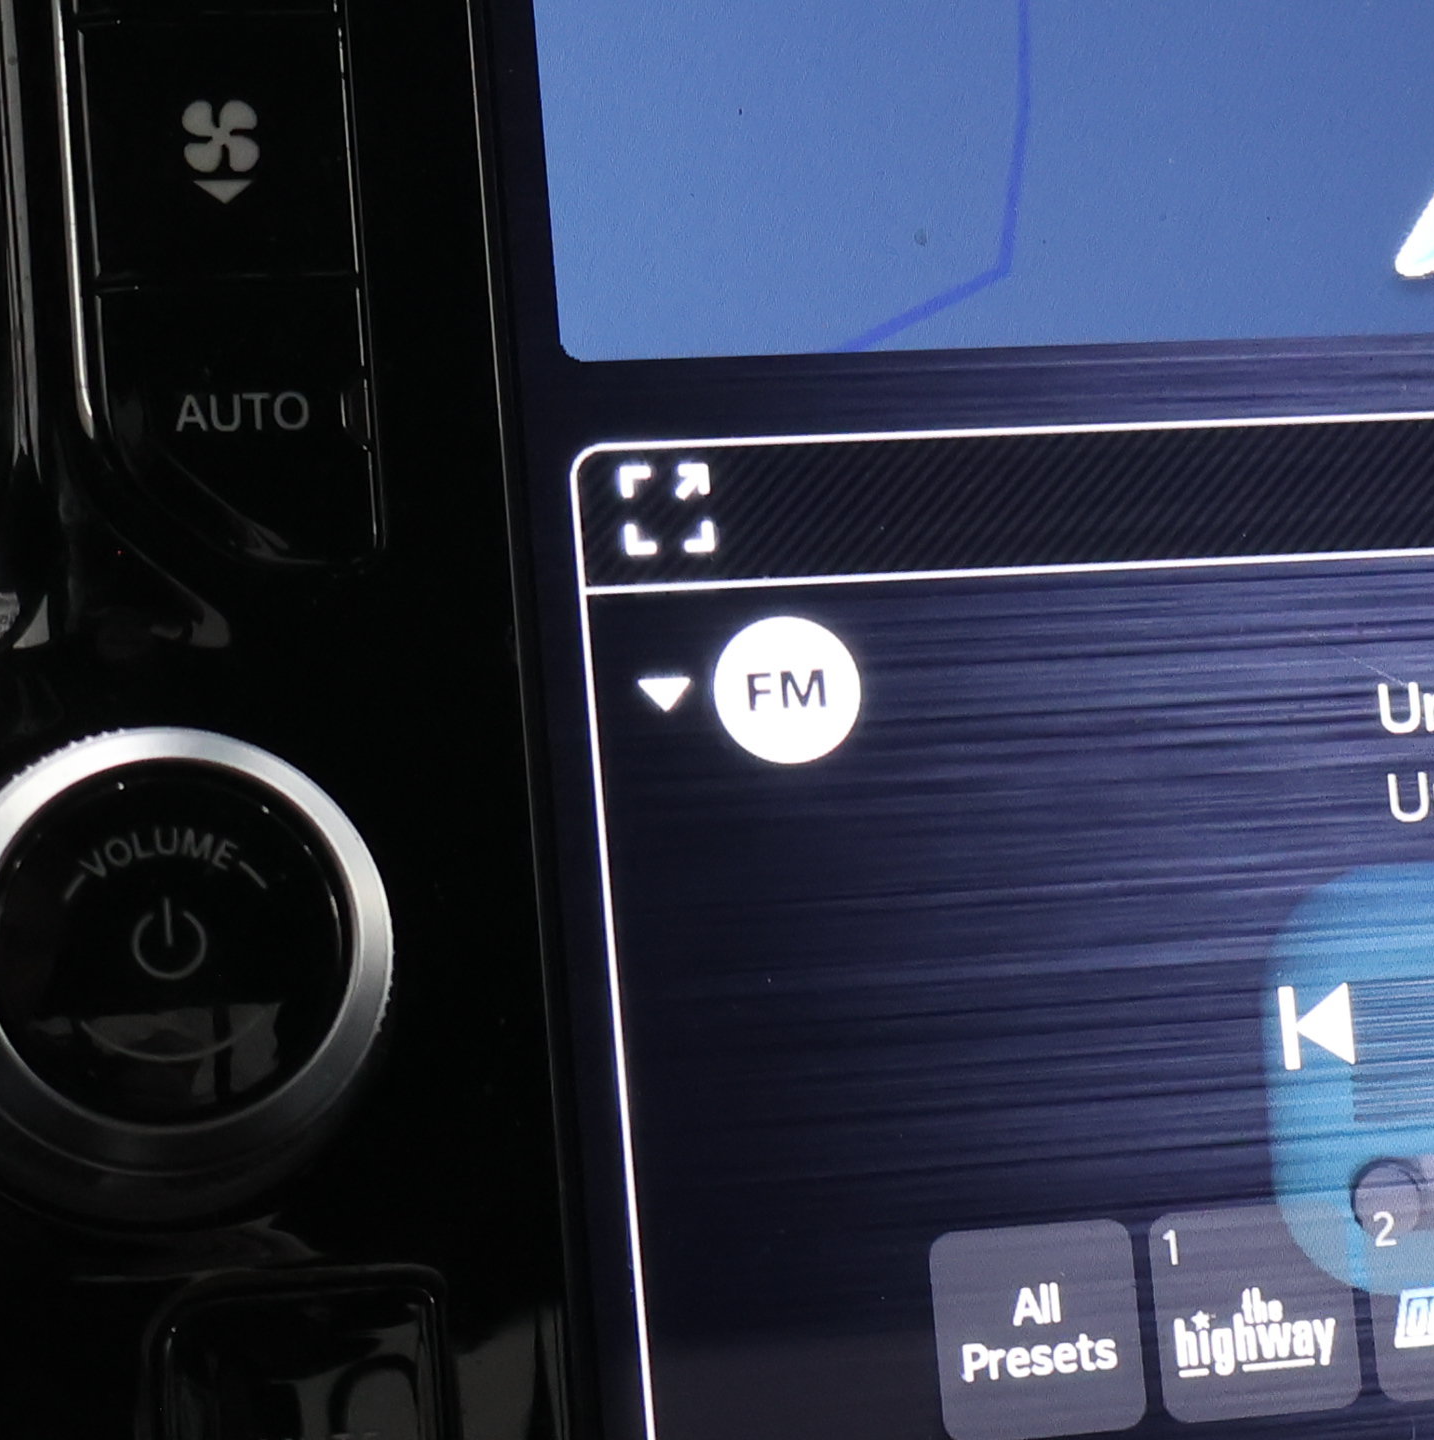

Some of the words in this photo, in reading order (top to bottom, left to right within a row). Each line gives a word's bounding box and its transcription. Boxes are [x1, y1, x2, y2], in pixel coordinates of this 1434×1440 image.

[177, 392, 308, 431] AUTO
[747, 668, 827, 712] FM
[78, 825, 239, 877] VOLUME
[1162, 1228, 1179, 1266] 1
[1374, 1212, 1396, 1247] 2
[1013, 1283, 1061, 1326] All
[1242, 1287, 1283, 1324] the
[963, 1334, 1117, 1382] Presets
[1173, 1312, 1336, 1376] highway
